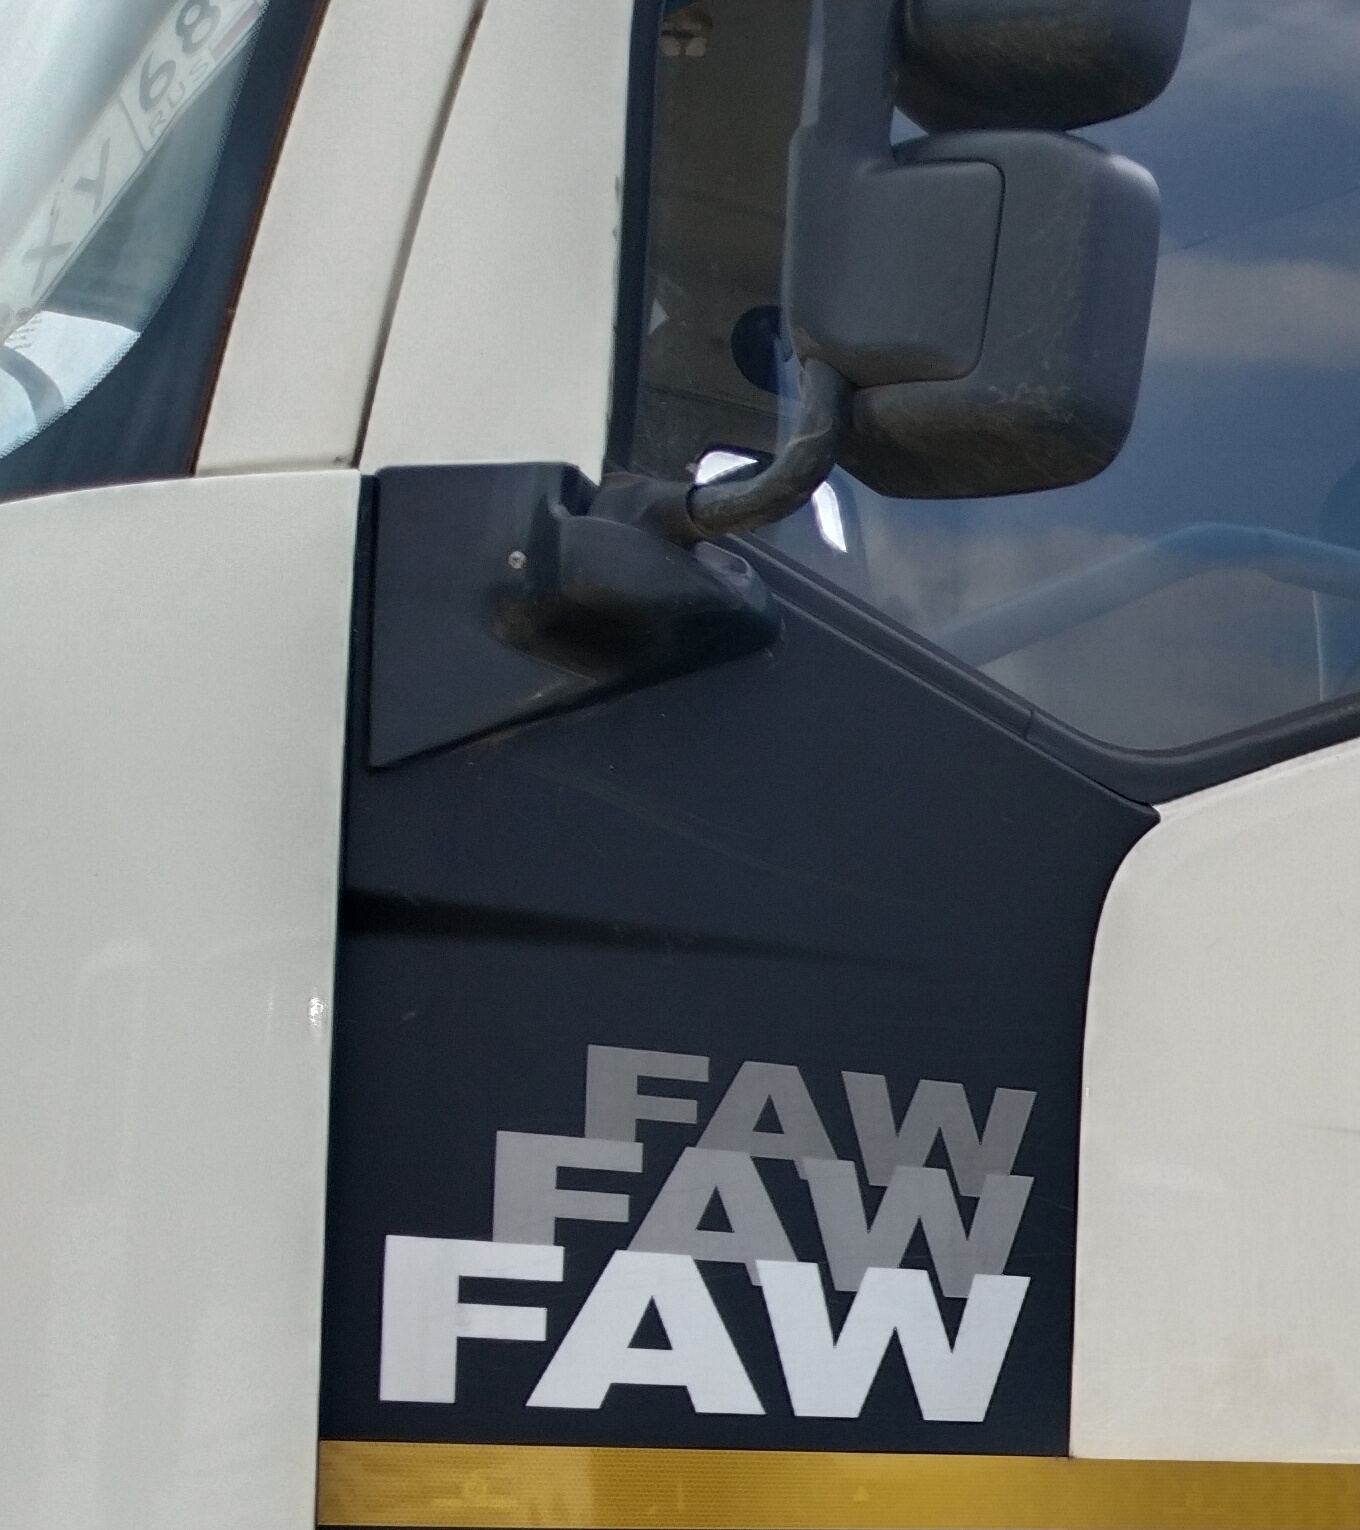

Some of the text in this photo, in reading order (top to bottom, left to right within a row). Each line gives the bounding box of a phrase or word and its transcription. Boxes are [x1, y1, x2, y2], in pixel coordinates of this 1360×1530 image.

[585, 1044, 1037, 1199] FAW
[493, 1131, 1034, 1299] FAW
[379, 1234, 1031, 1423] FAW
